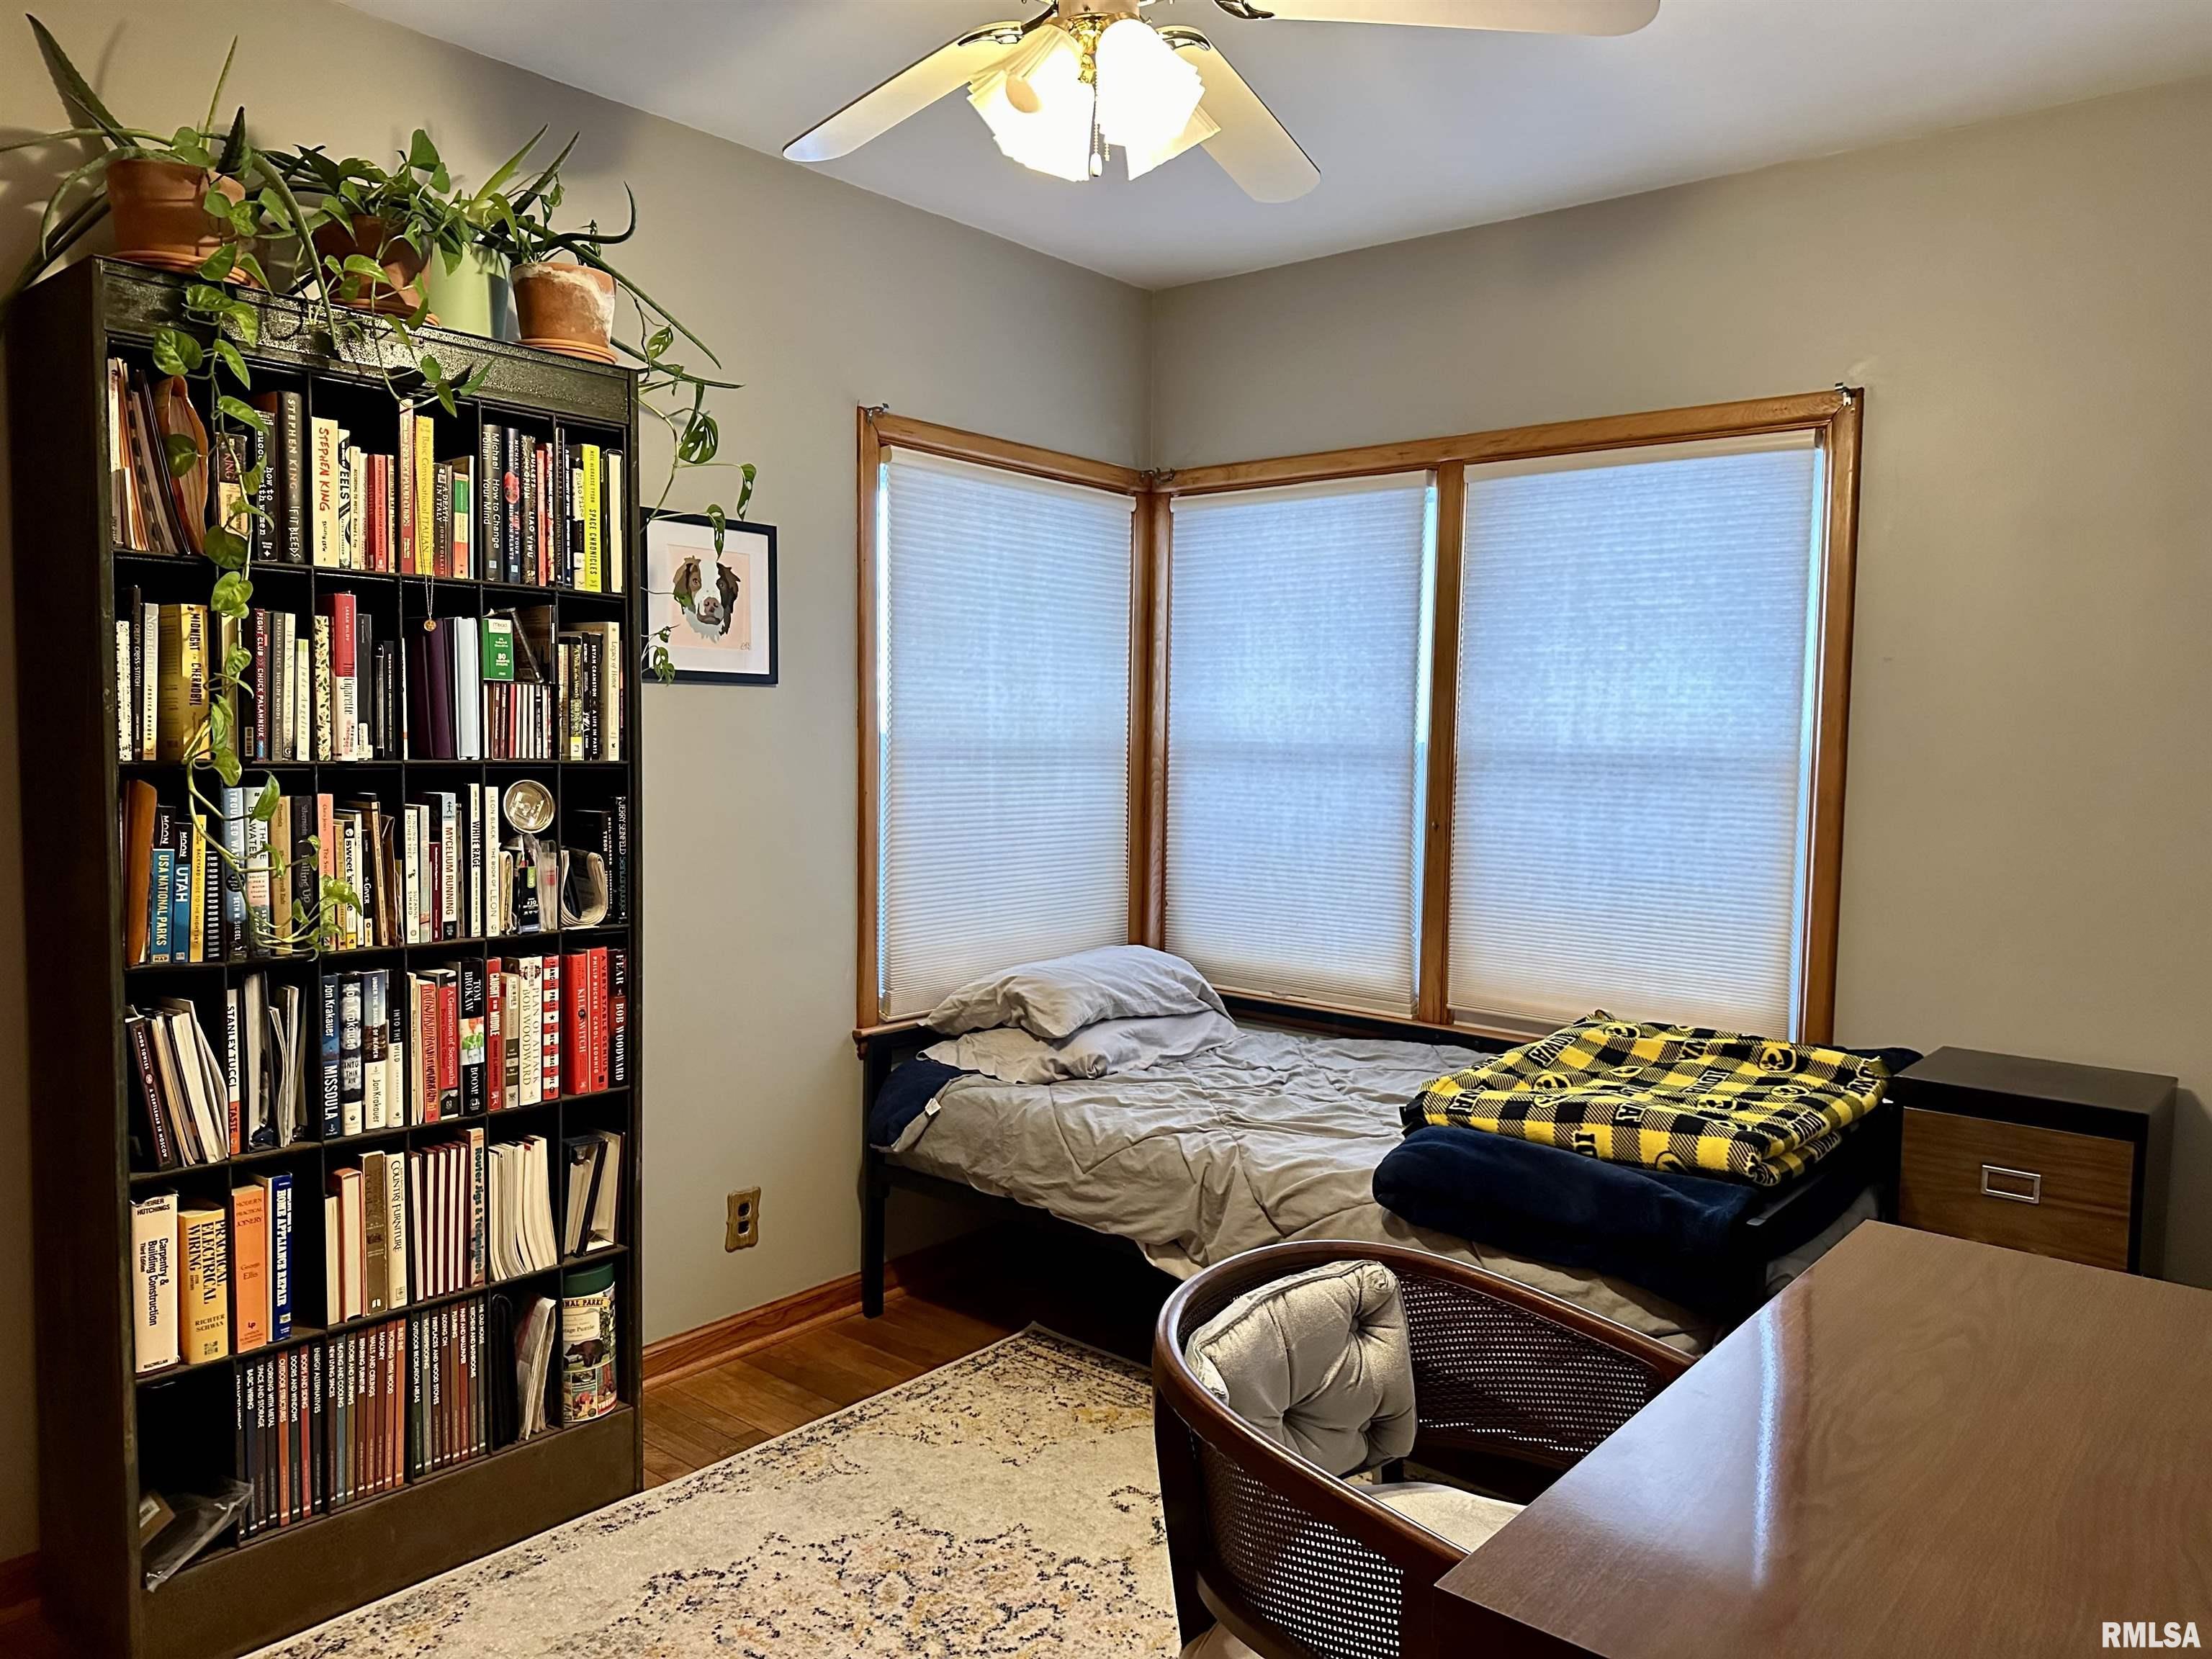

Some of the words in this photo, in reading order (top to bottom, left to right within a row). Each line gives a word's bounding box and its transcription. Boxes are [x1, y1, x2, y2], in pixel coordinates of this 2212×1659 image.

[288, 399, 297, 454] STEPHEN
[319, 428, 330, 475] STEPHEN
[482, 432, 491, 459] Pollan
[491, 433, 500, 469] Michael
[289, 459, 297, 490] KING
[339, 472, 349, 500] EELS
[421, 458, 430, 513] Conversational
[436, 485, 443, 495] IN
[266, 490, 274, 501] to
[319, 480, 330, 511] KING
[492, 503, 500, 511] to
[289, 527, 301, 558] BLEEDS
[491, 513, 501, 549] Change
[509, 523, 513, 532] ON
[147, 615, 158, 676] Nomadland
[189, 613, 200, 651] MIDNIGHT
[189, 663, 202, 706] CHERNOBYL
[343, 662, 355, 677] The
[340, 678, 354, 715] Cigarette
[158, 855, 169, 873] USA
[346, 840, 354, 872] sweet
[157, 876, 168, 914] NATIONAL
[176, 867, 188, 902] UTAH
[302, 889, 311, 903] Up
[617, 857, 626, 911] SeinLanguage
[156, 917, 166, 945] PARKS
[490, 973, 499, 998] CAUGHT
[616, 954, 624, 984] FEAR
[324, 985, 336, 998] Jon
[346, 986, 356, 1002] Jon
[464, 972, 474, 1012] BROKAW
[522, 989, 531, 1011] BOB
[227, 1007, 235, 1051] STANLEY
[325, 999, 336, 1036] Krakauer
[347, 1005, 358, 1048] Krakauer
[490, 1012, 500, 1036] MIDDLE
[533, 1021, 540, 1035] OF
[616, 1003, 624, 1022] BOB
[140, 1048, 149, 1070] TOWLES
[523, 1015, 531, 1085] WOODWARD
[615, 1025, 624, 1080] WOODWARD
[1527, 1033, 1577, 1067] IOWA
[324, 1065, 338, 1120] MISSOULA
[391, 1160, 402, 1202] COUNTRY
[473, 1185, 482, 1205] Jigs
[276, 1190, 287, 1217] HOME
[276, 1219, 287, 1269] APPLIANCE
[392, 1205, 403, 1252] FURNITURE
[474, 1217, 483, 1274] Techniques
[146, 1241, 158, 1274] Building
[158, 1238, 168, 1277] Carpentry
[188, 1224, 202, 1272] WIRING
[202, 1222, 217, 1304] ELECTRICAL
[215, 1220, 228, 1287] PRACTICAL
[148, 1275, 158, 1326] Construction
[276, 1272, 287, 1307] REPAIR
[195, 1314, 225, 1326] RICHTER
[442, 1336, 447, 1346] ON
